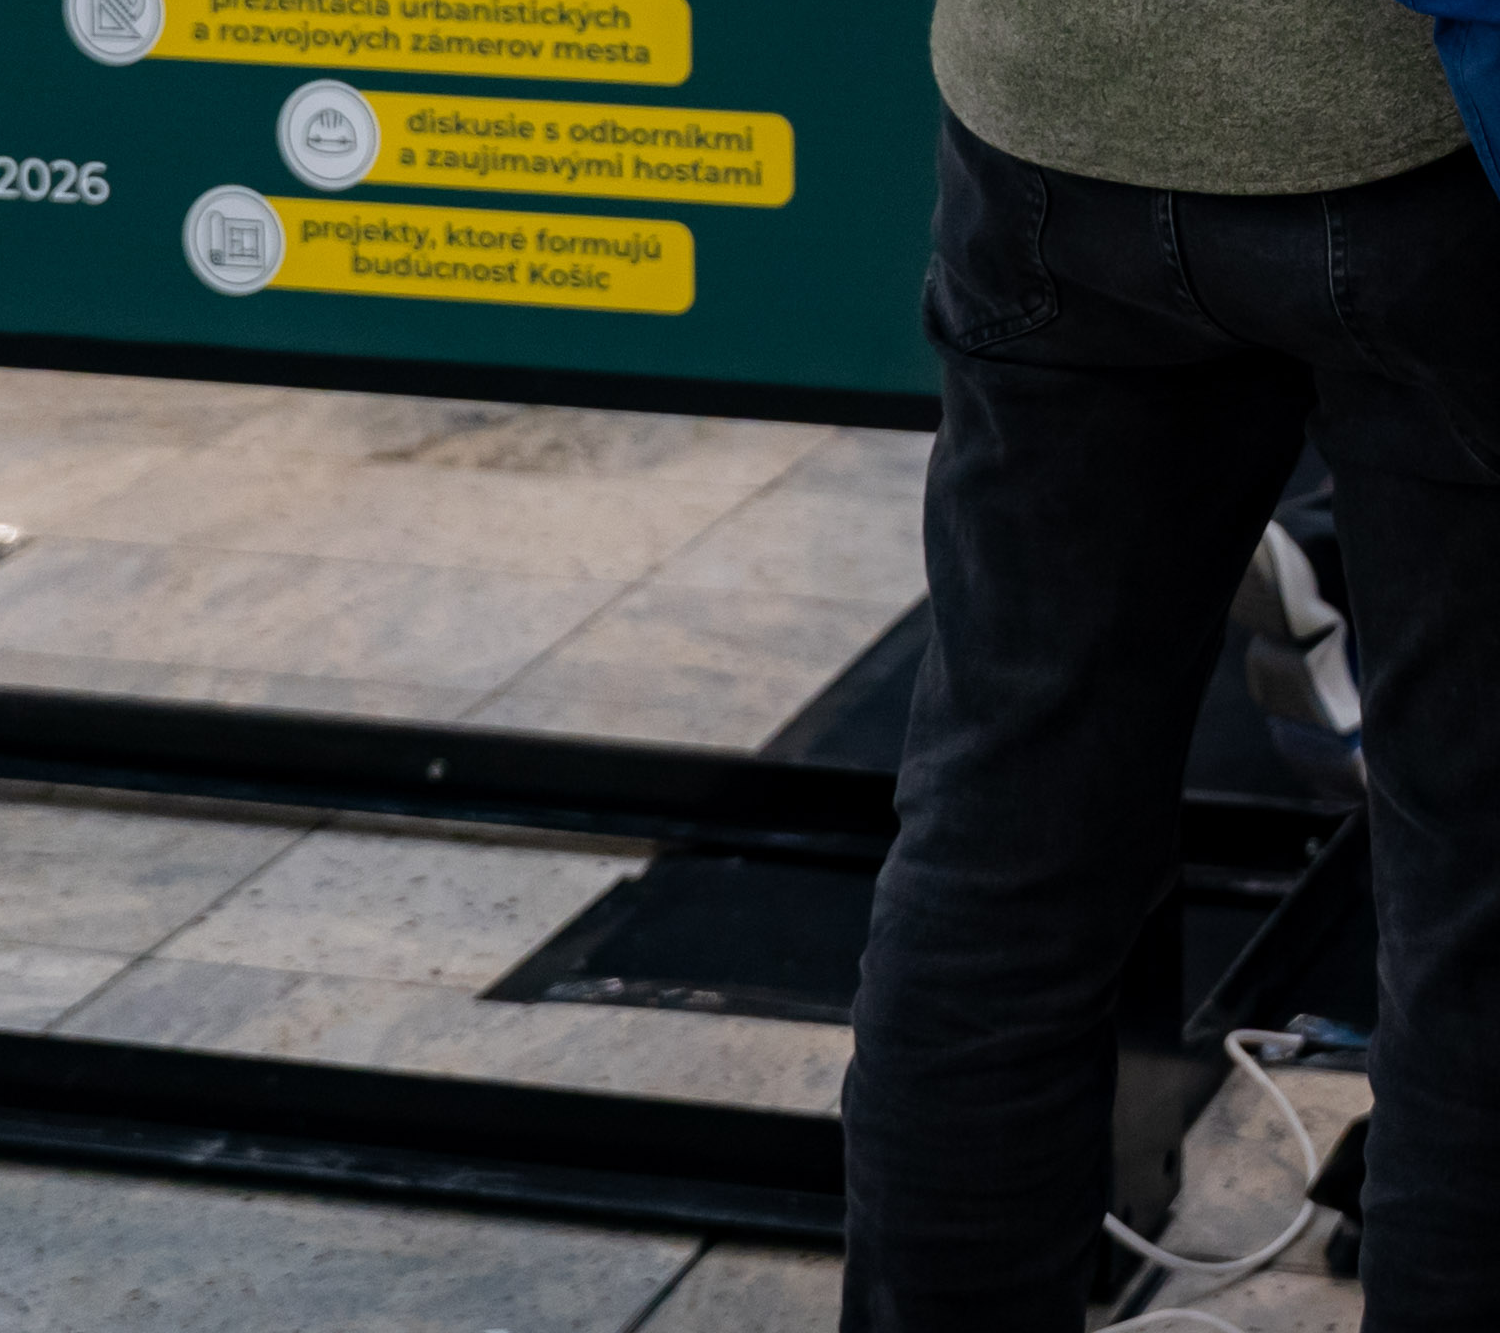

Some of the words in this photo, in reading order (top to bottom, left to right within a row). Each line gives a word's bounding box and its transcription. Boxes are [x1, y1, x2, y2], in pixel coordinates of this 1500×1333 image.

[193, 23, 210, 42] a
[218, 20, 401, 56] rozvojových
[411, 27, 543, 61] zámerov
[553, 37, 651, 65] mesta
[407, 108, 536, 143] diskusie
[544, 123, 561, 143] s
[569, 116, 754, 153] odborníkmi
[399, 146, 417, 166] a
[424, 144, 624, 184] zaujímavými
[632, 155, 763, 188] hosťami
[301, 217, 438, 252] projekty,
[446, 223, 526, 254] ktoré
[536, 229, 662, 264] formujú
[351, 251, 519, 286] budúcnosť
[528, 260, 612, 291] Košíc
